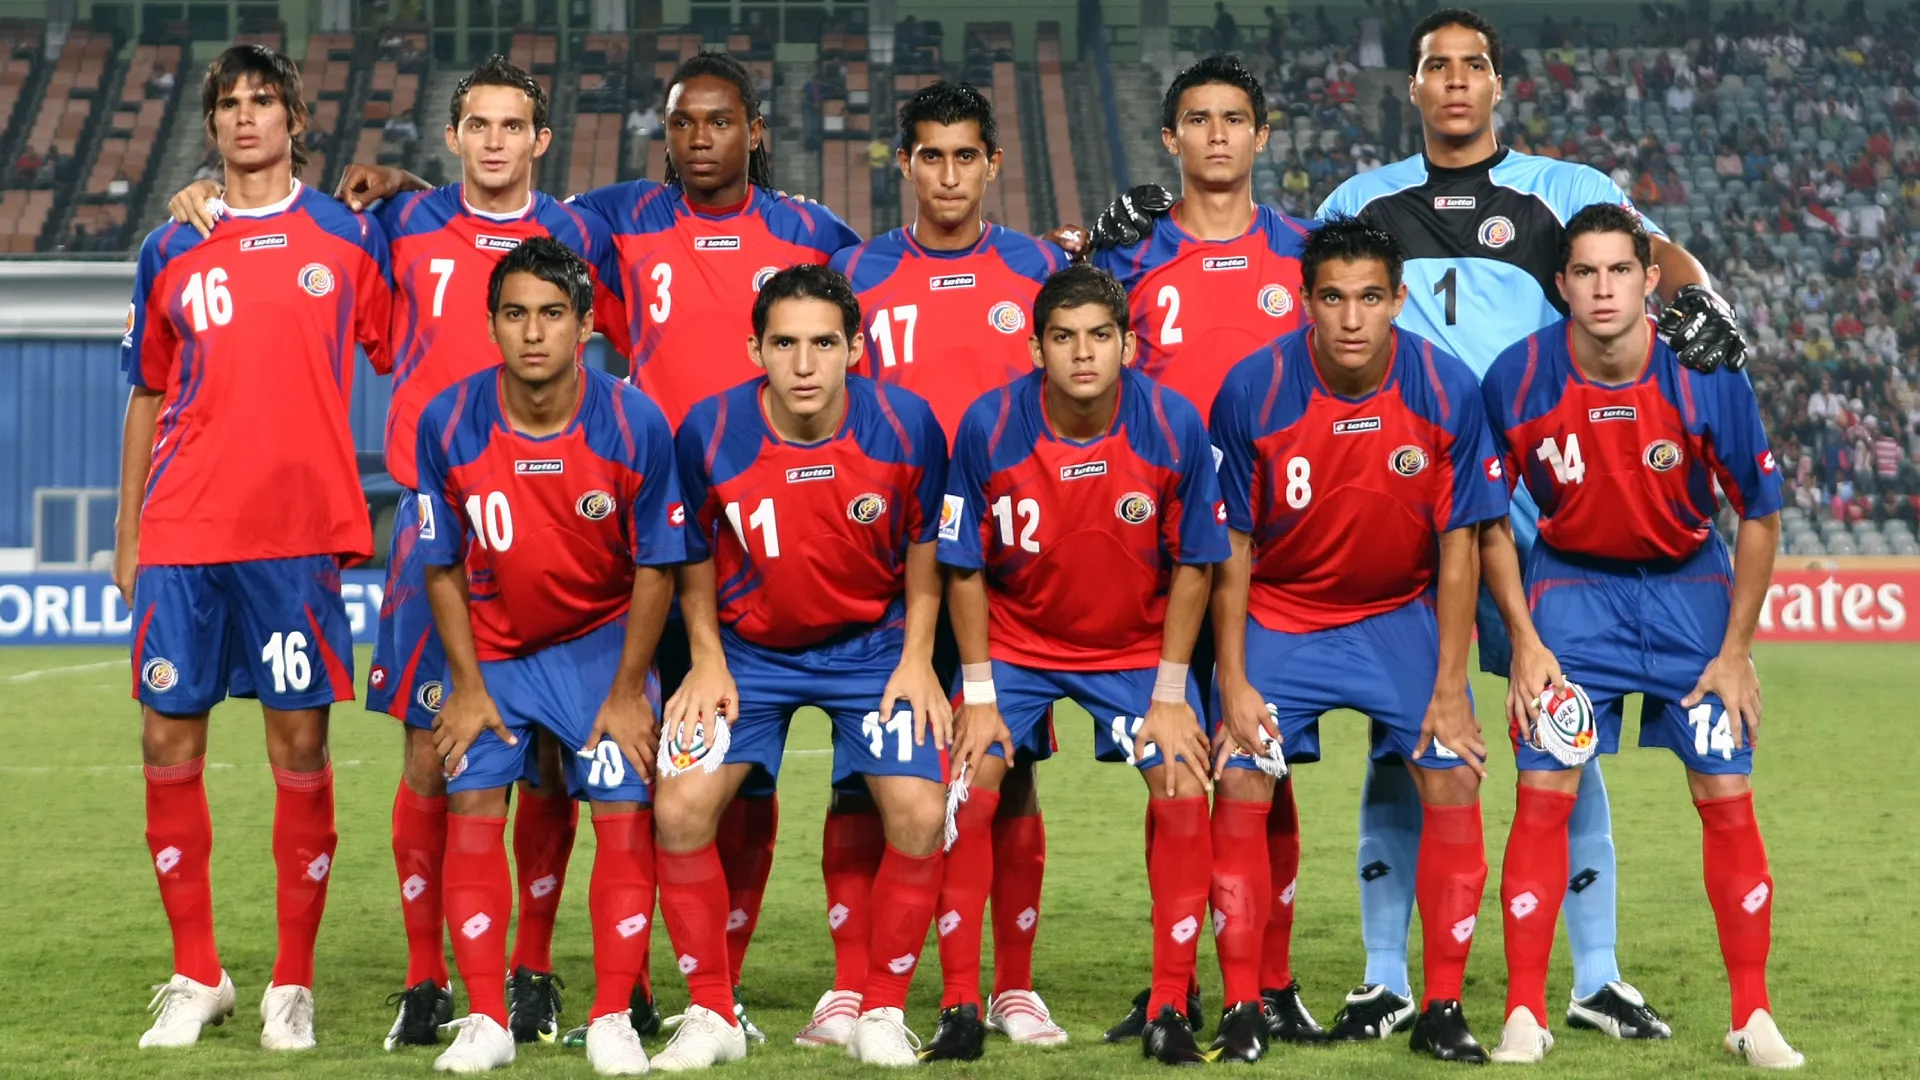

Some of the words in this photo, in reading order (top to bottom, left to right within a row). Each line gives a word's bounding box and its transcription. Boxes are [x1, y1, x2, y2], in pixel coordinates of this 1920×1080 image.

[182, 267, 233, 332] 16
[430, 258, 455, 317] 7
[649, 262, 672, 323] 3
[1157, 285, 1183, 345] 2
[1433, 267, 1457, 326] 1
[869, 304, 918, 367] 17
[1285, 456, 1312, 509] 8
[1536, 432, 1585, 485] 14
[465, 490, 514, 551] 10
[724, 498, 780, 558] 11
[992, 495, 1040, 553] 12
[1758, 575, 1908, 632] rates
[262, 630, 312, 693] 16
[861, 710, 913, 762] 11
[1557, 703, 1577, 724] UAE
[1563, 717, 1576, 729] FA
[1688, 703, 1737, 761] 14
